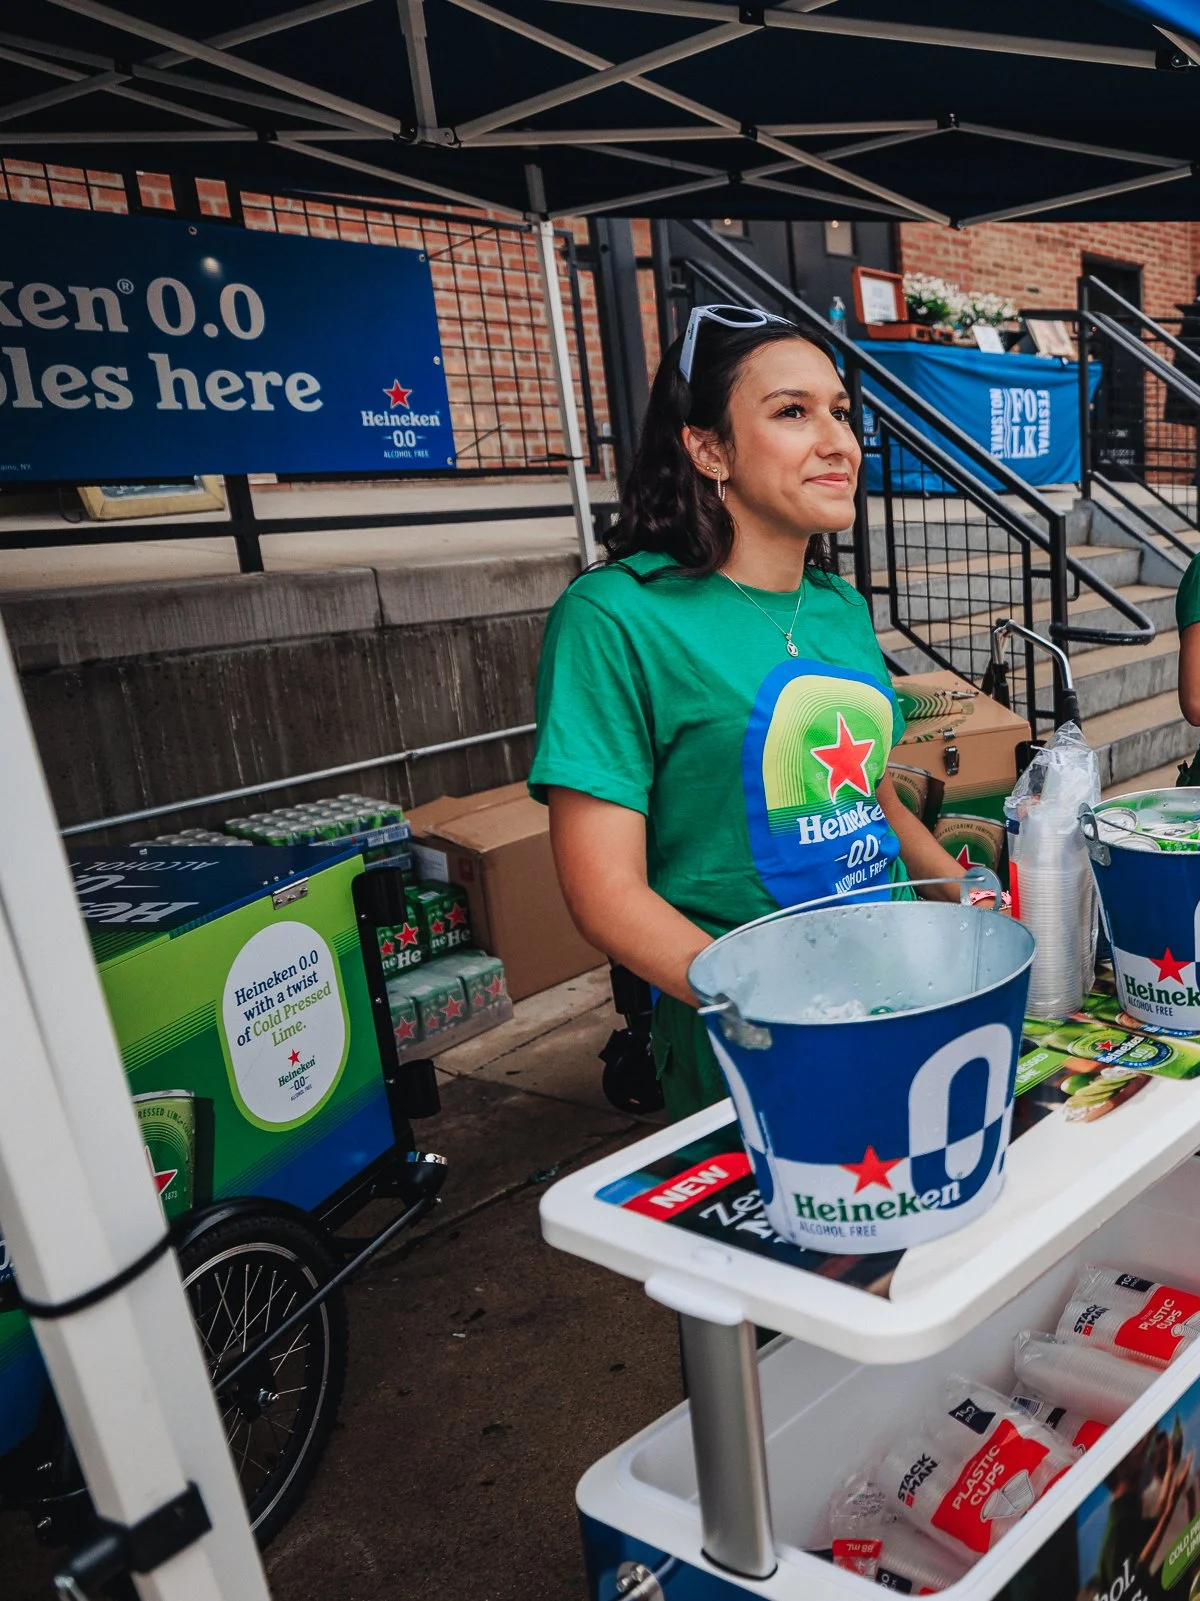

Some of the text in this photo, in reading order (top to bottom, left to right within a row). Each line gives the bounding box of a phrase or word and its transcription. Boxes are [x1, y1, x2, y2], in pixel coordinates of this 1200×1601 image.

[147, 277, 265, 340] 0.0
[0, 347, 323, 412] les here
[361, 410, 440, 426] Heineken
[1037, 390, 1050, 457] FESTIVAL
[835, 868, 867, 895] ALCOHOL
[234, 949, 319, 1006] Heineken 0.0
[243, 970, 319, 1022] with a twist
[237, 981, 332, 1047] of Cold Pressed
[1128, 997, 1174, 1017] ALCOHOL FREE
[271, 1020, 307, 1047] Lime.
[278, 1058, 316, 1088] Heineken
[137, 1107, 165, 1120] RESSED
[649, 1164, 729, 1209] NEW
[792, 1181, 961, 1222] Heineken
[800, 1221, 877, 1238] ALCOHOL FREE
[1138, 1298, 1175, 1331] PLASTIC
[1156, 1309, 1183, 1329] CUPS
[897, 1452, 932, 1502] STACK
[909, 1459, 939, 1497] MAN
[952, 1444, 1001, 1511] PLASTIC
[969, 1461, 1005, 1506] CUPS
[1168, 1533, 1190, 1566] COLD
